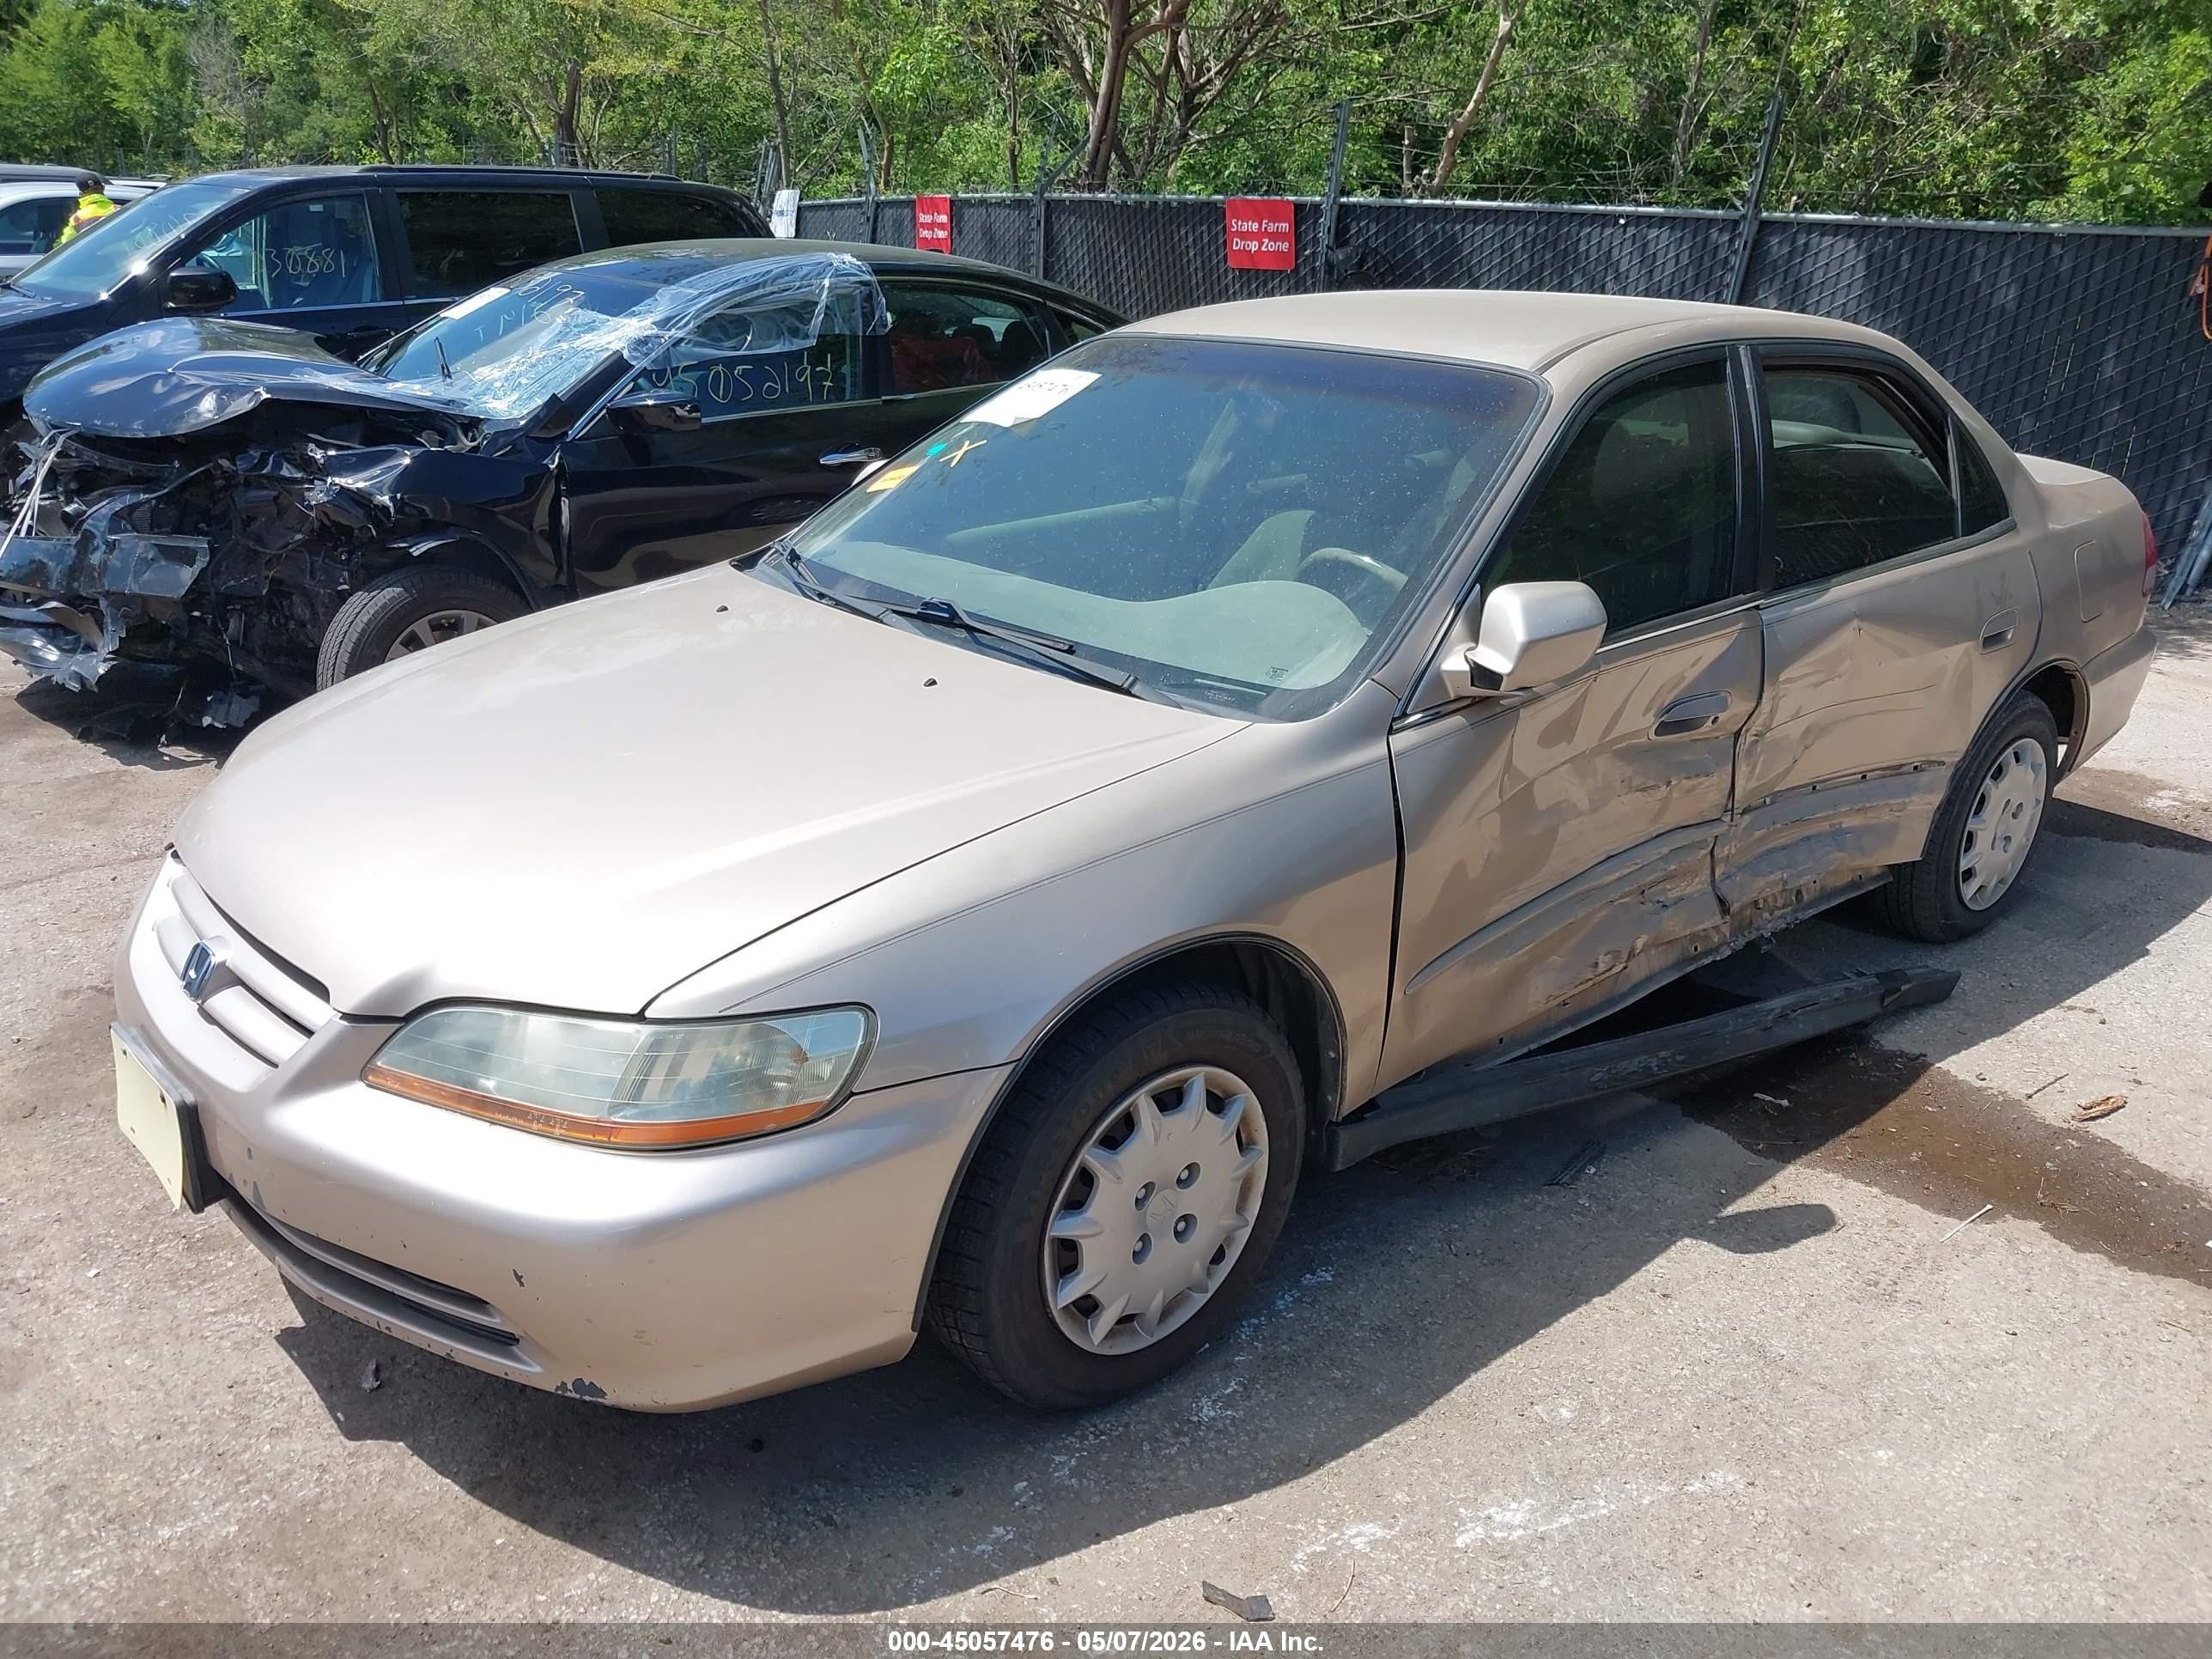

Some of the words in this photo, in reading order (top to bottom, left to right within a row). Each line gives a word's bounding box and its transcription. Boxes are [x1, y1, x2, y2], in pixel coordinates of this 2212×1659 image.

[919, 213, 933, 223] State
[933, 212, 948, 223] Farm
[1231, 219, 1259, 233] State
[1261, 220, 1290, 233] Farm
[919, 228, 933, 240] Drop
[933, 228, 948, 240] Zone
[1232, 238, 1259, 254] Drop
[1261, 239, 1290, 252] Zone
